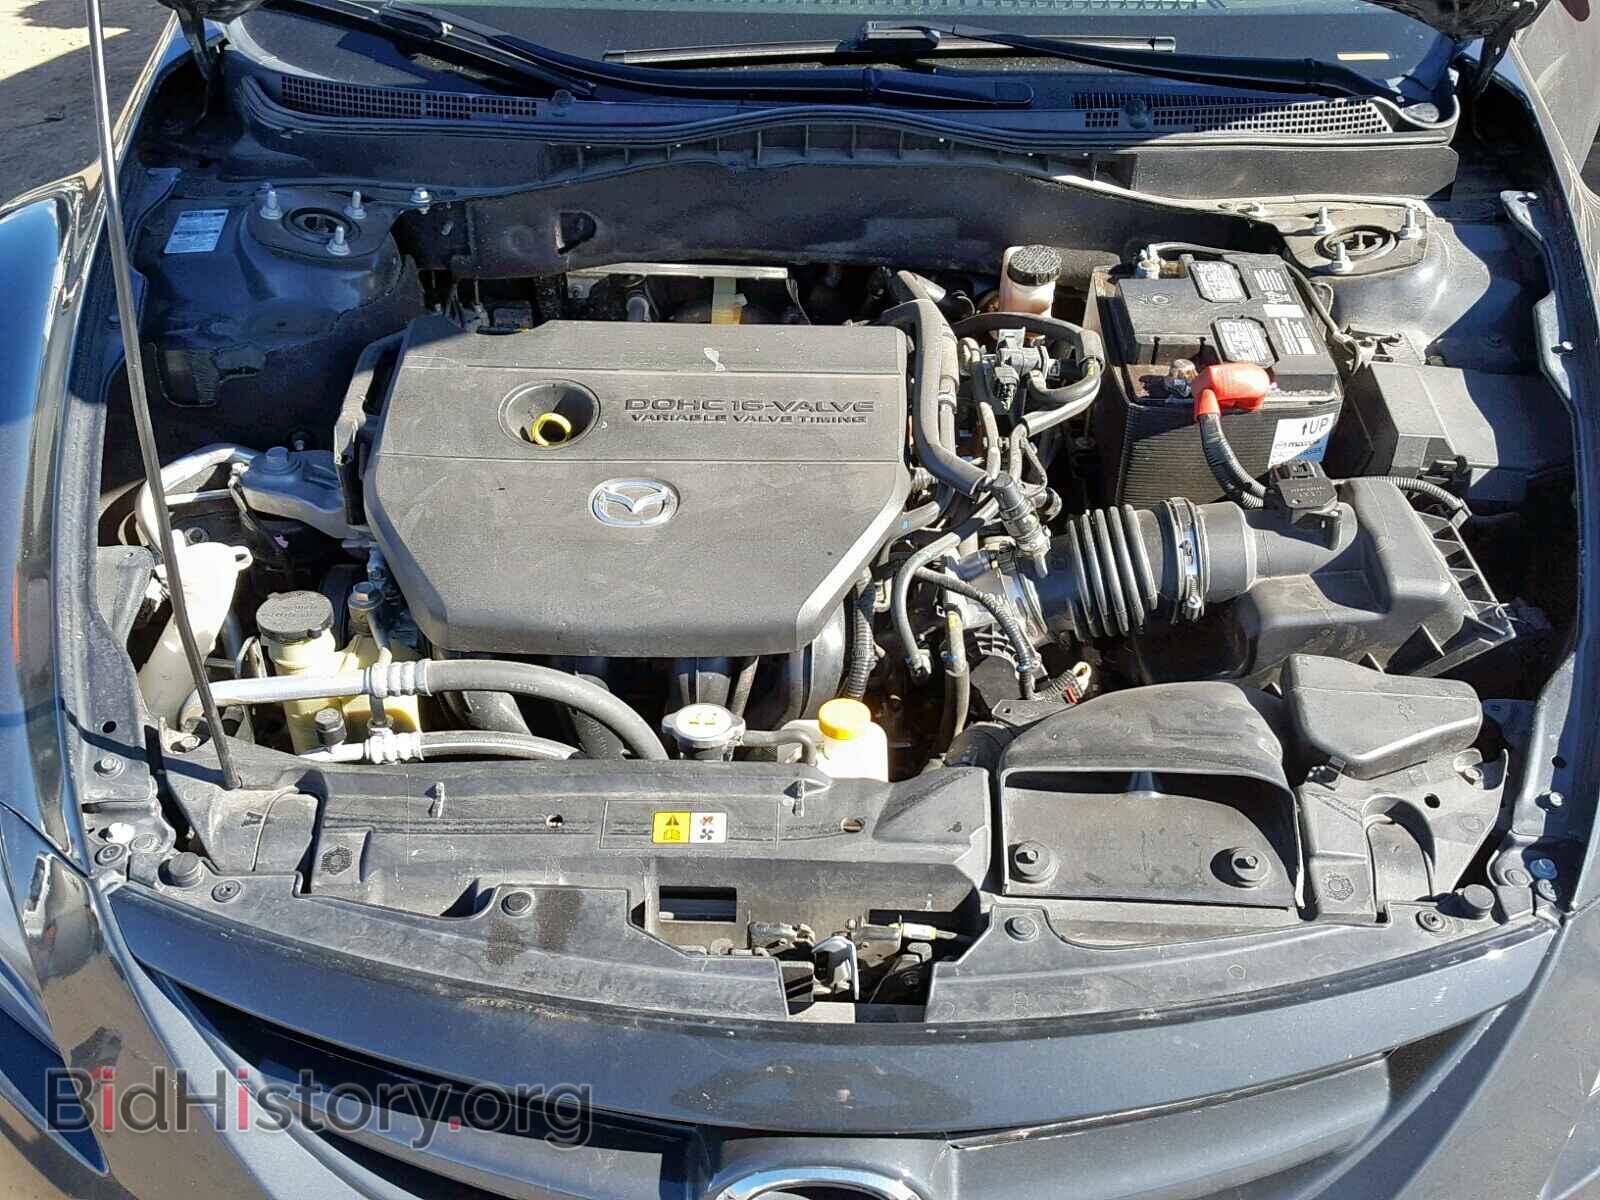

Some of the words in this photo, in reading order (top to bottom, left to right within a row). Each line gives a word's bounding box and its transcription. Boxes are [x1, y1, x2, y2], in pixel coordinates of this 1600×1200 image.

[624, 398, 726, 411] DOHC
[731, 399, 875, 413] 16-VALVE
[631, 413, 729, 424] VARIABLE
[733, 414, 793, 424] VALVE
[800, 415, 867, 425] TIMING
[1309, 416, 1329, 434] UP
